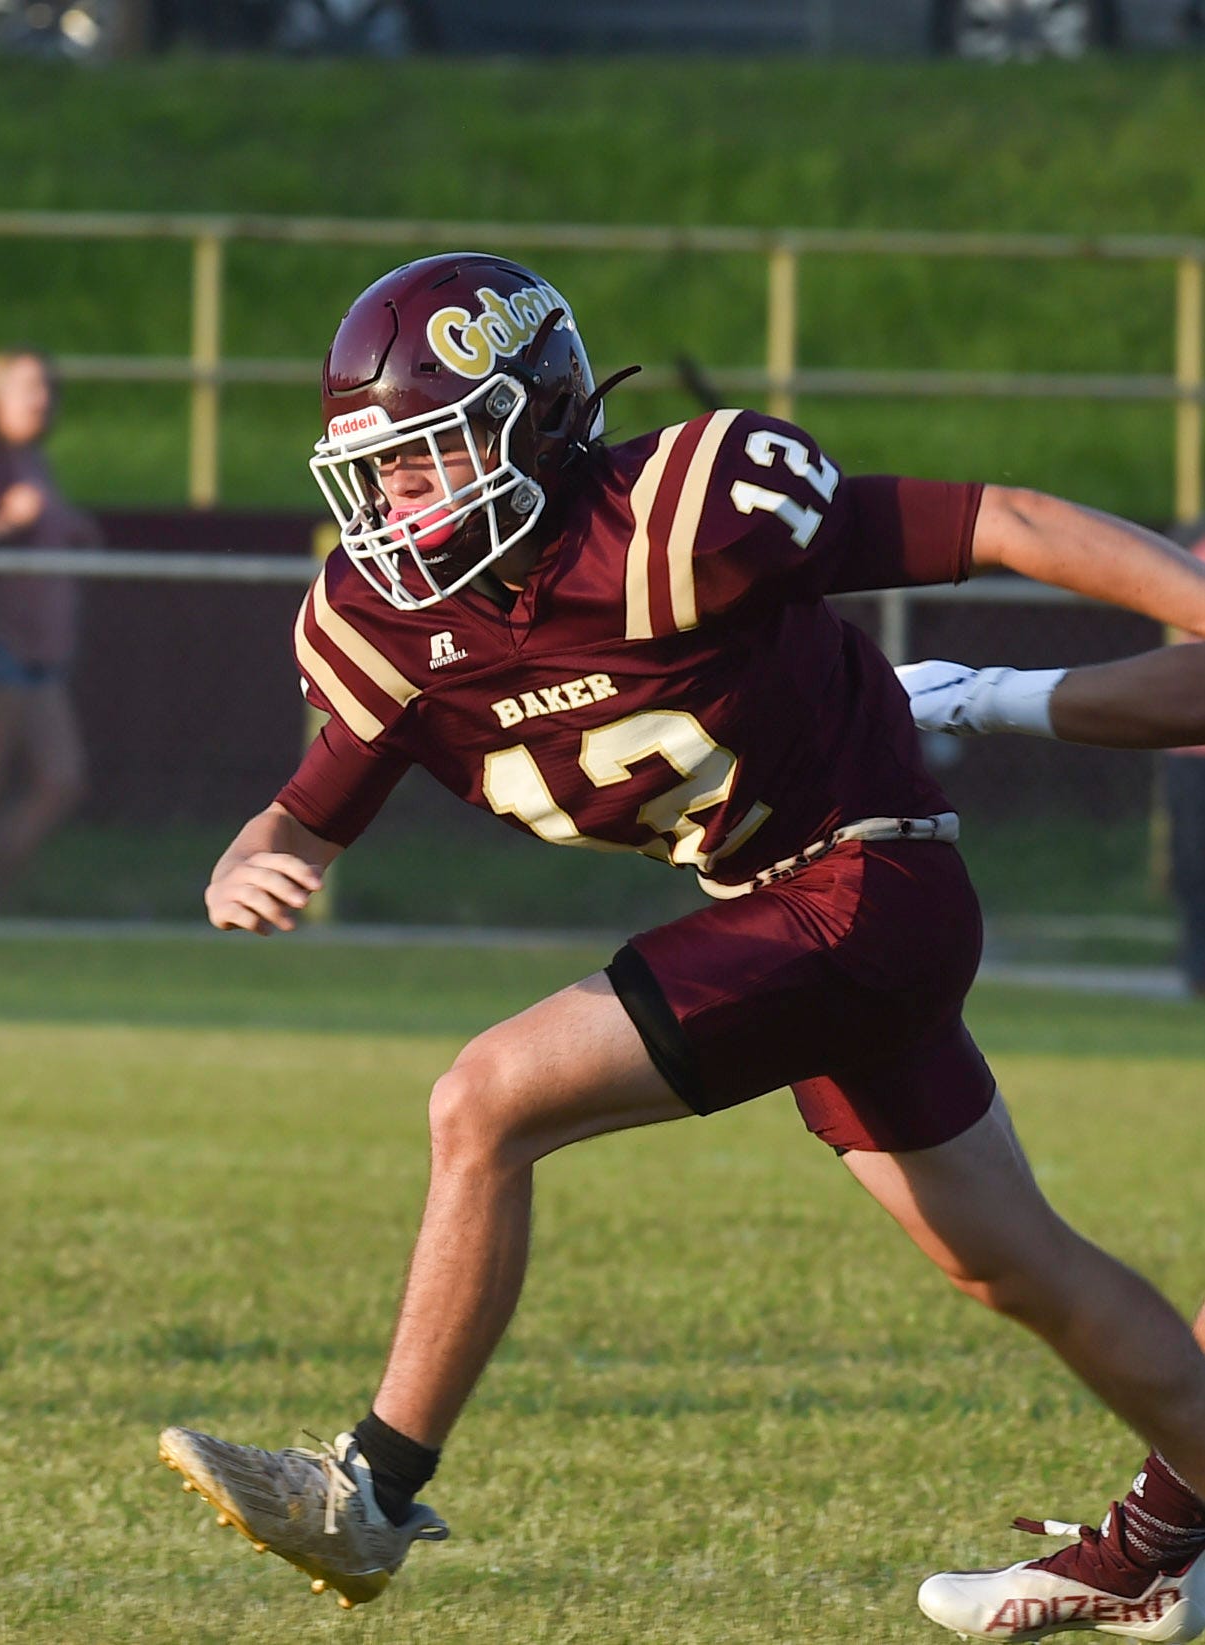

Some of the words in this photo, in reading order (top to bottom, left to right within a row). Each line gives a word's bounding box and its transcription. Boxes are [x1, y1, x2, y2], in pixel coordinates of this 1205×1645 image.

[331, 411, 377, 437] Riddell
[730, 430, 840, 549] 12
[429, 648, 469, 670] RUSSELL
[490, 673, 620, 729] BAKER
[482, 709, 773, 873] 12
